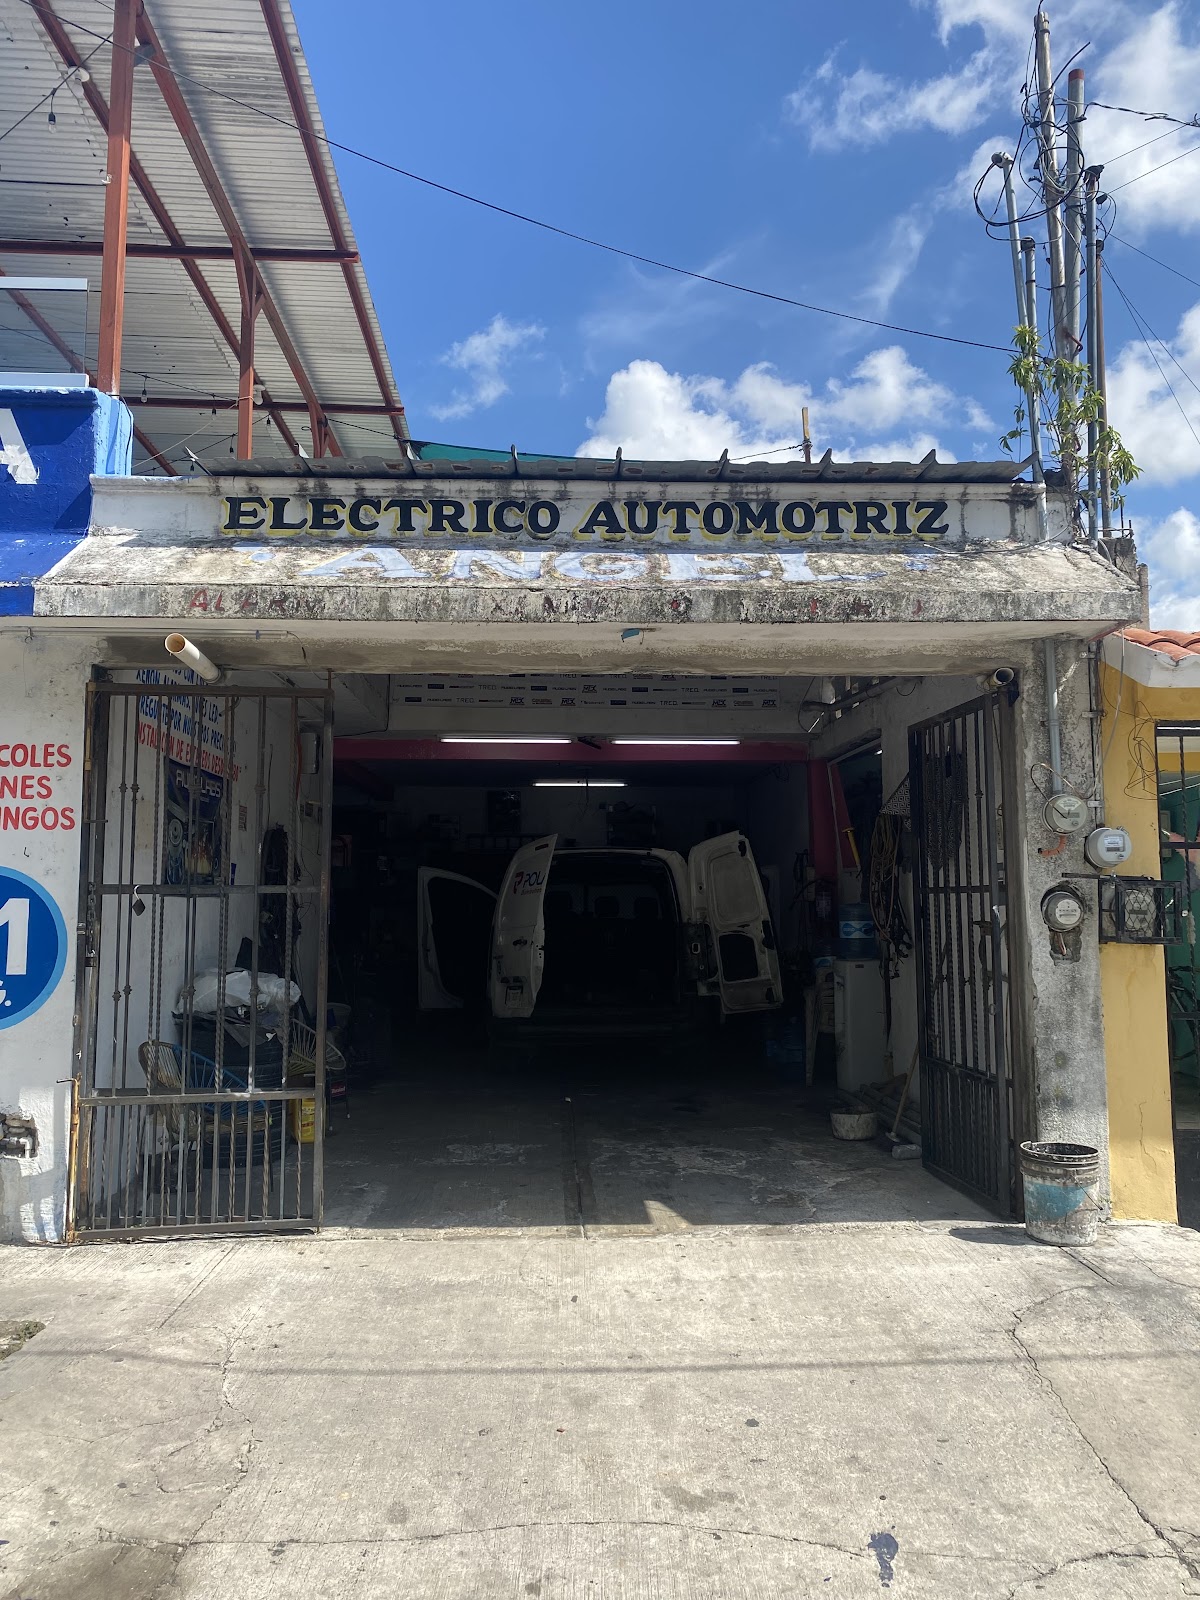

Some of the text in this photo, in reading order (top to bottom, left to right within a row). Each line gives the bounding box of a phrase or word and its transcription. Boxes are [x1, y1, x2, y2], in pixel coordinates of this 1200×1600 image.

[221, 496, 949, 541] ELECTRICO AUTOMOTRIZ
[294, 543, 888, 582] ANGEL
[0, 806, 76, 831] NGOS
